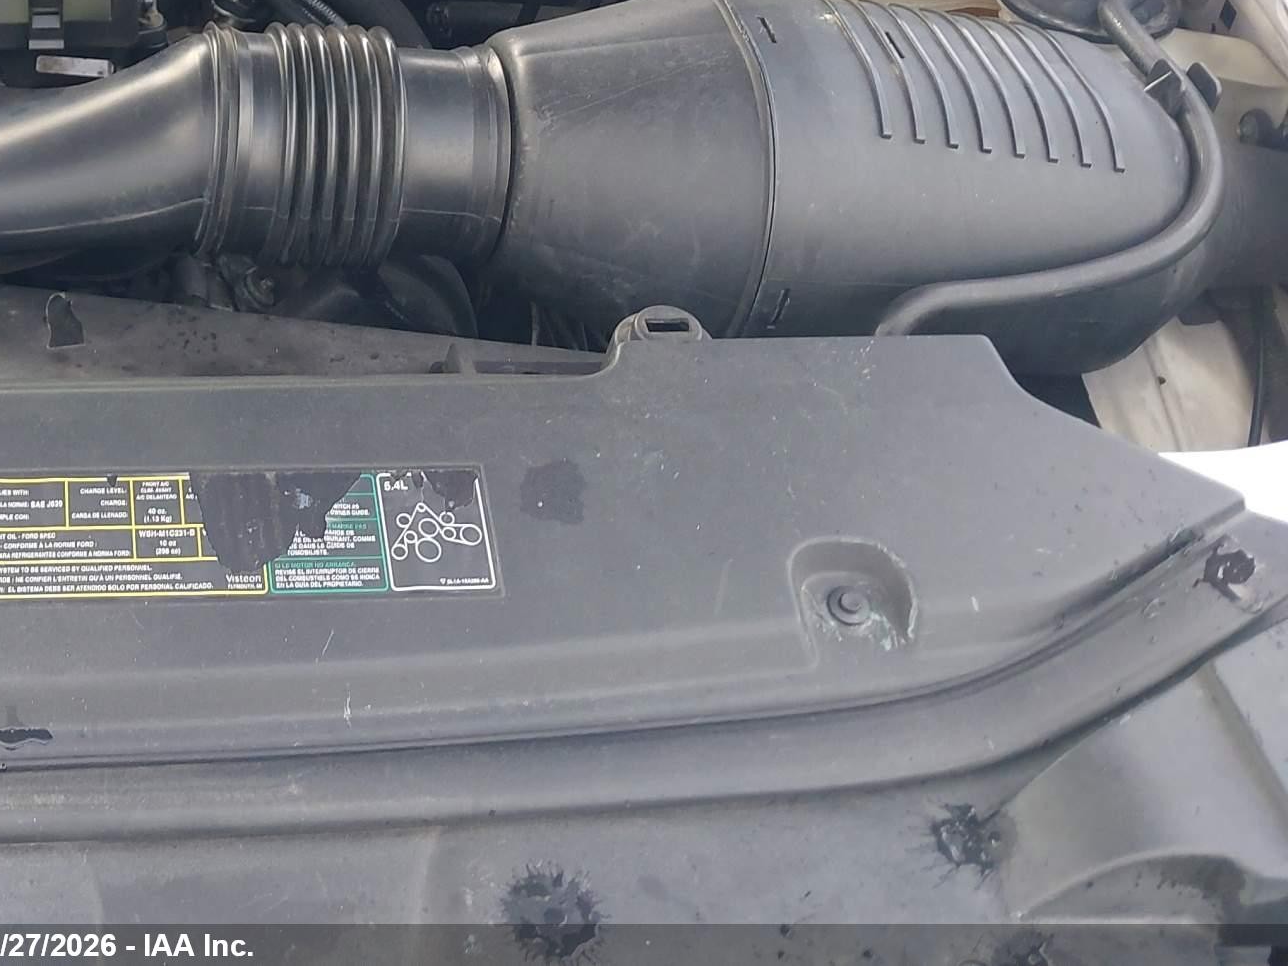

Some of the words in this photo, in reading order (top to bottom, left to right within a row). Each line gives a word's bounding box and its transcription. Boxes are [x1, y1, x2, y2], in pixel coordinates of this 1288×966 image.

[226, 574, 262, 583] Visteon
[17, 585, 43, 593] SISTEMA
[76, 584, 106, 592] ATENDIDO
[140, 583, 174, 591] PERSONAL
